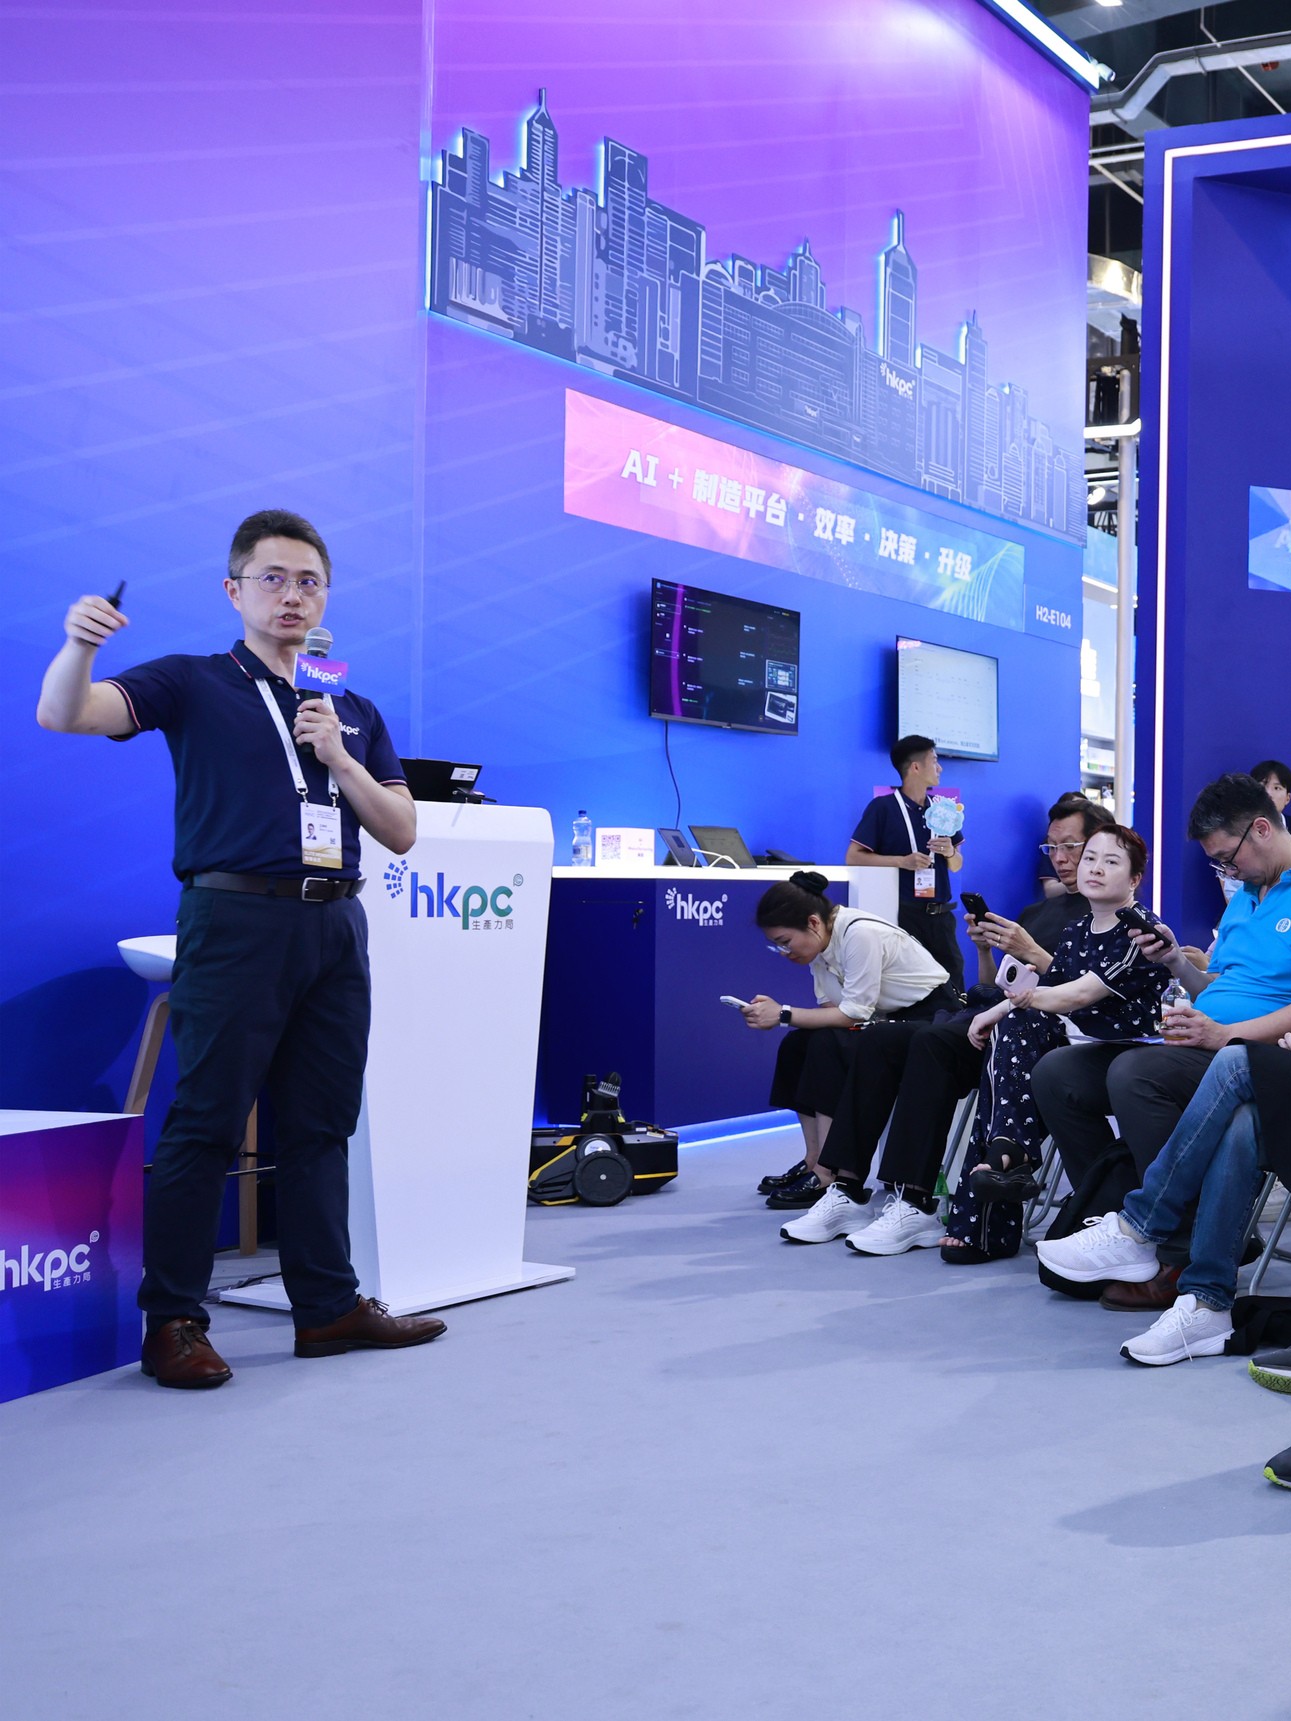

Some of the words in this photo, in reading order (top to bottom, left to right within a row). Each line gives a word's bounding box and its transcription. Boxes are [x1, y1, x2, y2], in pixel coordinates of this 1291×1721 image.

[885, 367, 913, 397] hkpc
[620, 448, 660, 487] AI
[668, 467, 684, 489] +
[692, 468, 789, 527] 制造平台
[813, 507, 857, 545] 效率
[937, 546, 973, 581] 升级
[1035, 604, 1072, 630] H2-E104
[306, 666, 339, 684] hkpc
[340, 721, 358, 736] kpc
[410, 872, 514, 931] hkpc
[676, 893, 724, 927] hkpc
[472, 919, 514, 931] 生產力局
[0, 1244, 91, 1292] hkpc
[53, 1271, 91, 1290] 生產力局
